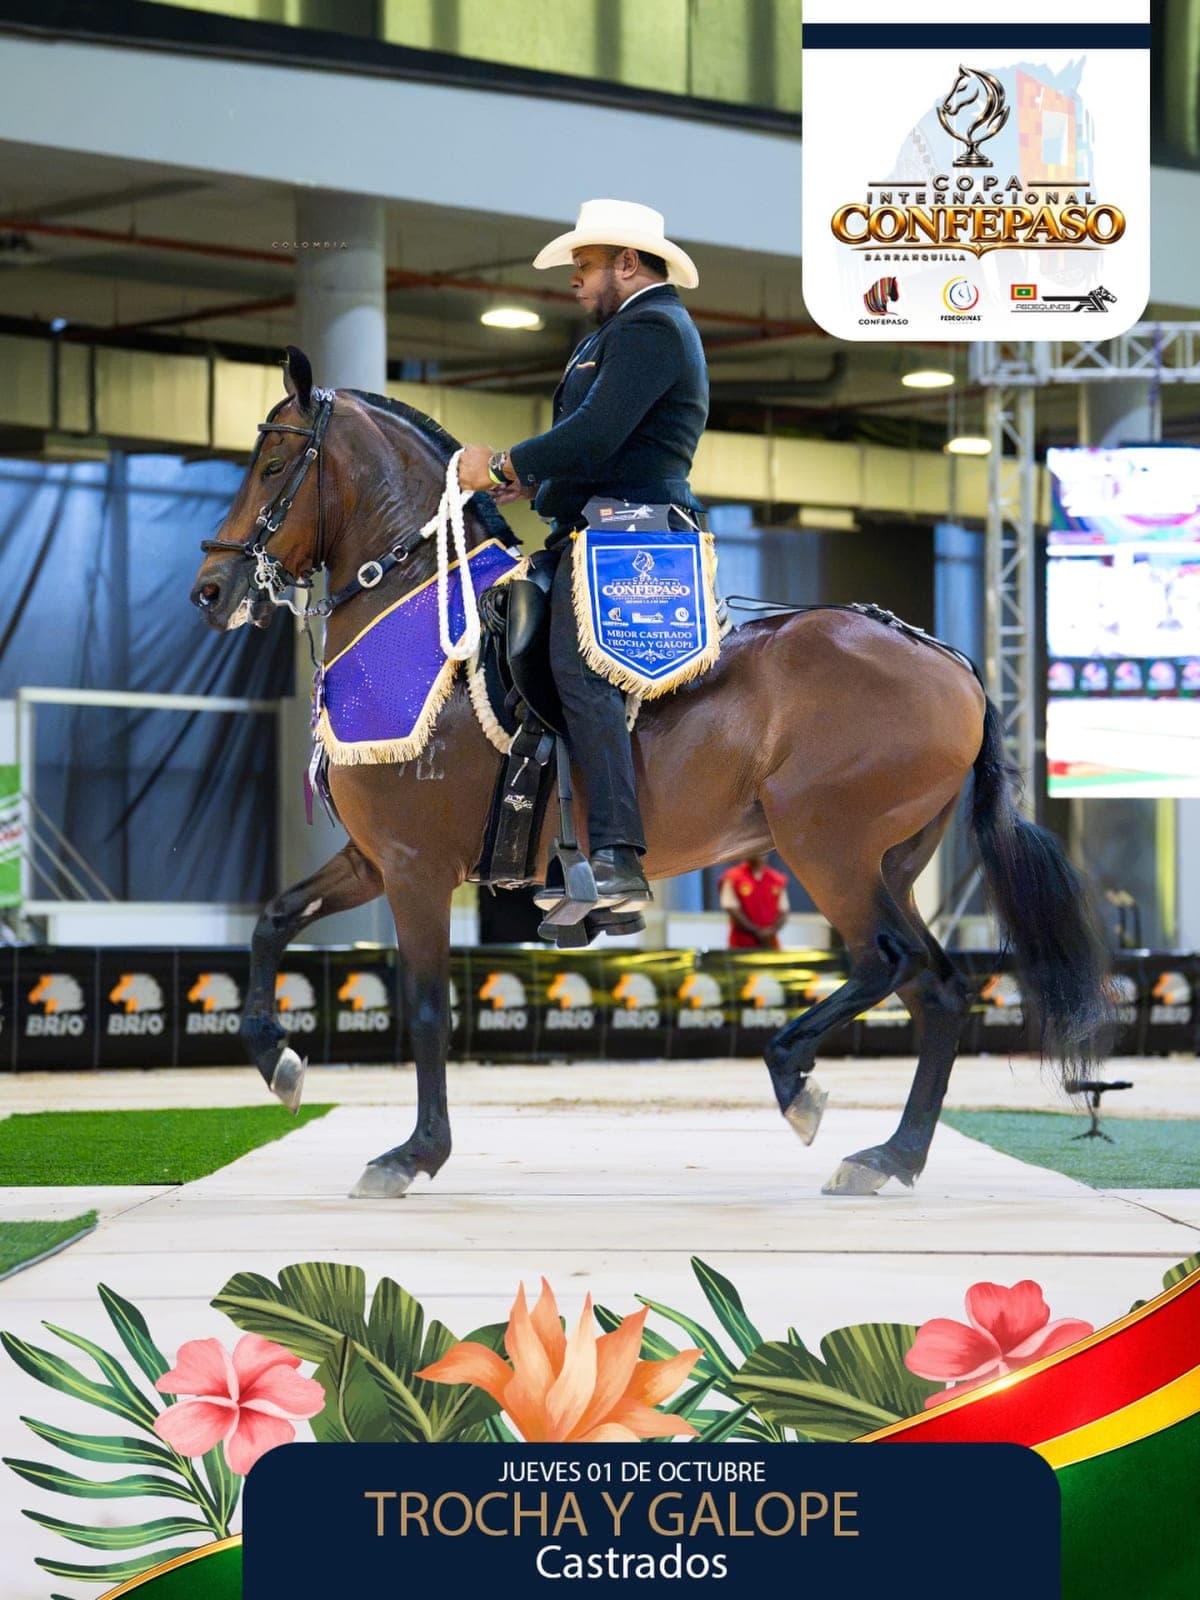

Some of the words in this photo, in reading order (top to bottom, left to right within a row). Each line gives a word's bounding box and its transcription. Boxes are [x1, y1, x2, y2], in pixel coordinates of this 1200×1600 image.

[602, 585, 691, 596] CONFEPASO
[607, 630, 638, 638] MEJOR
[639, 631, 692, 639] CASTRADO
[607, 639, 646, 647] TROCHA
[647, 640, 654, 649] Y
[655, 641, 694, 649] GALOPE
